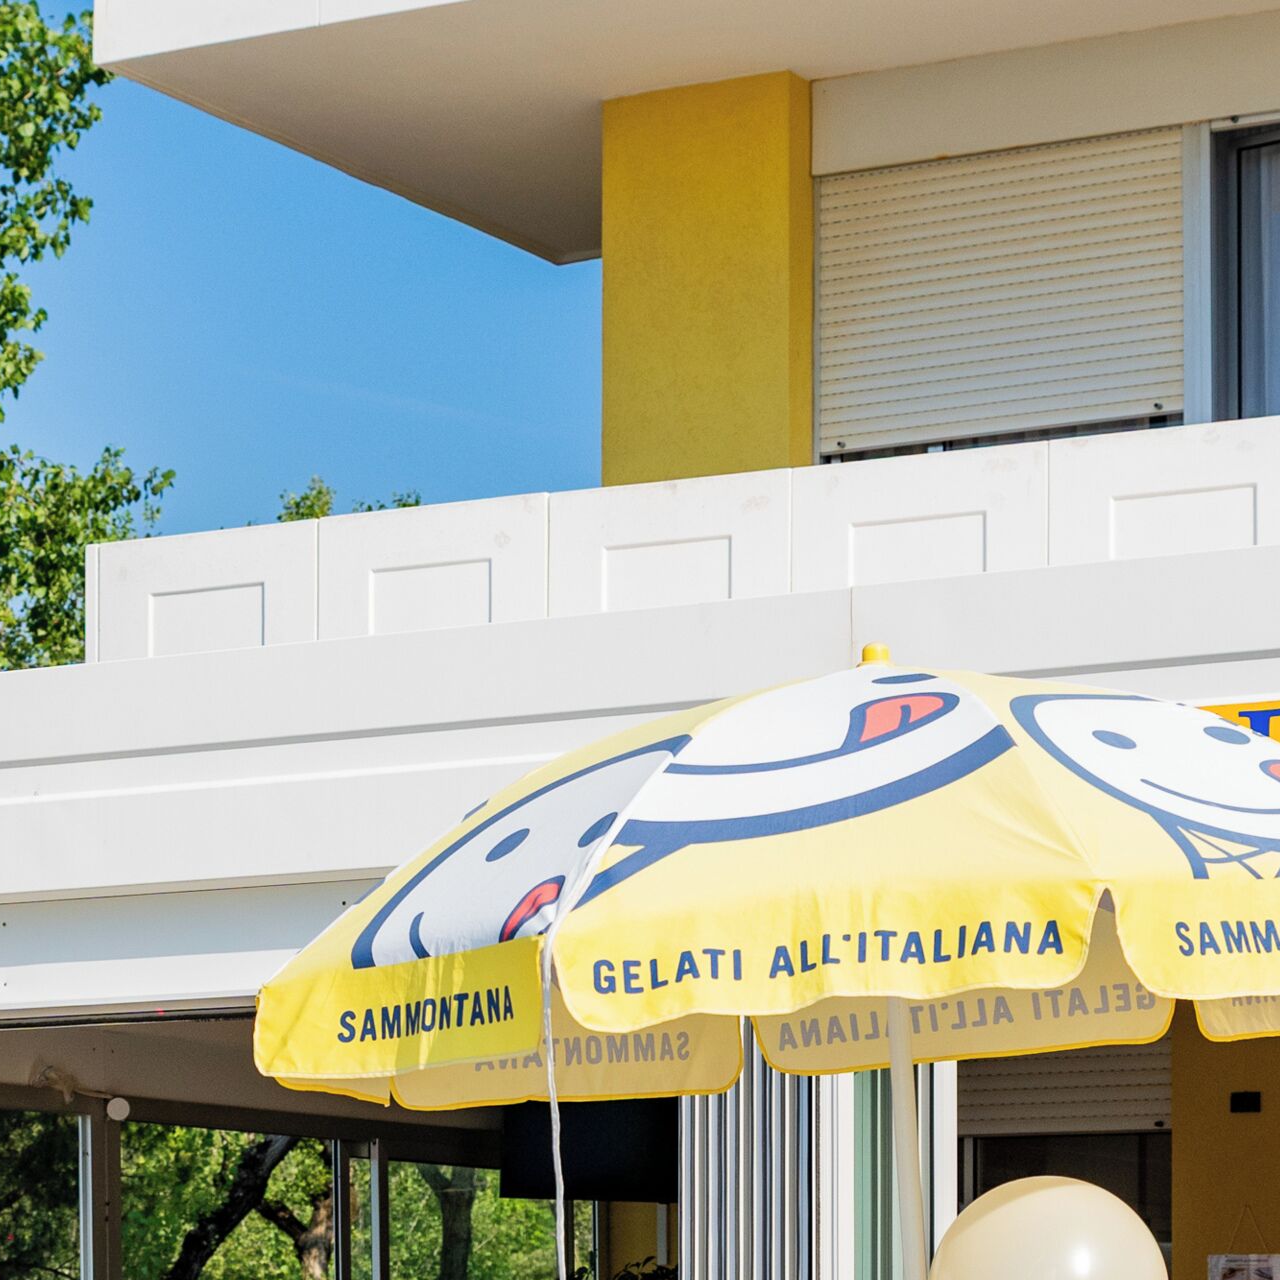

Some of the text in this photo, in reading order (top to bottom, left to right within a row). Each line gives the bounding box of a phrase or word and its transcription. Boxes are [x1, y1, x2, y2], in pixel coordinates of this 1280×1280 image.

[593, 919, 1064, 997] GELATI ALL'ITALIANA
[337, 984, 514, 1043] SAMMONTANA
